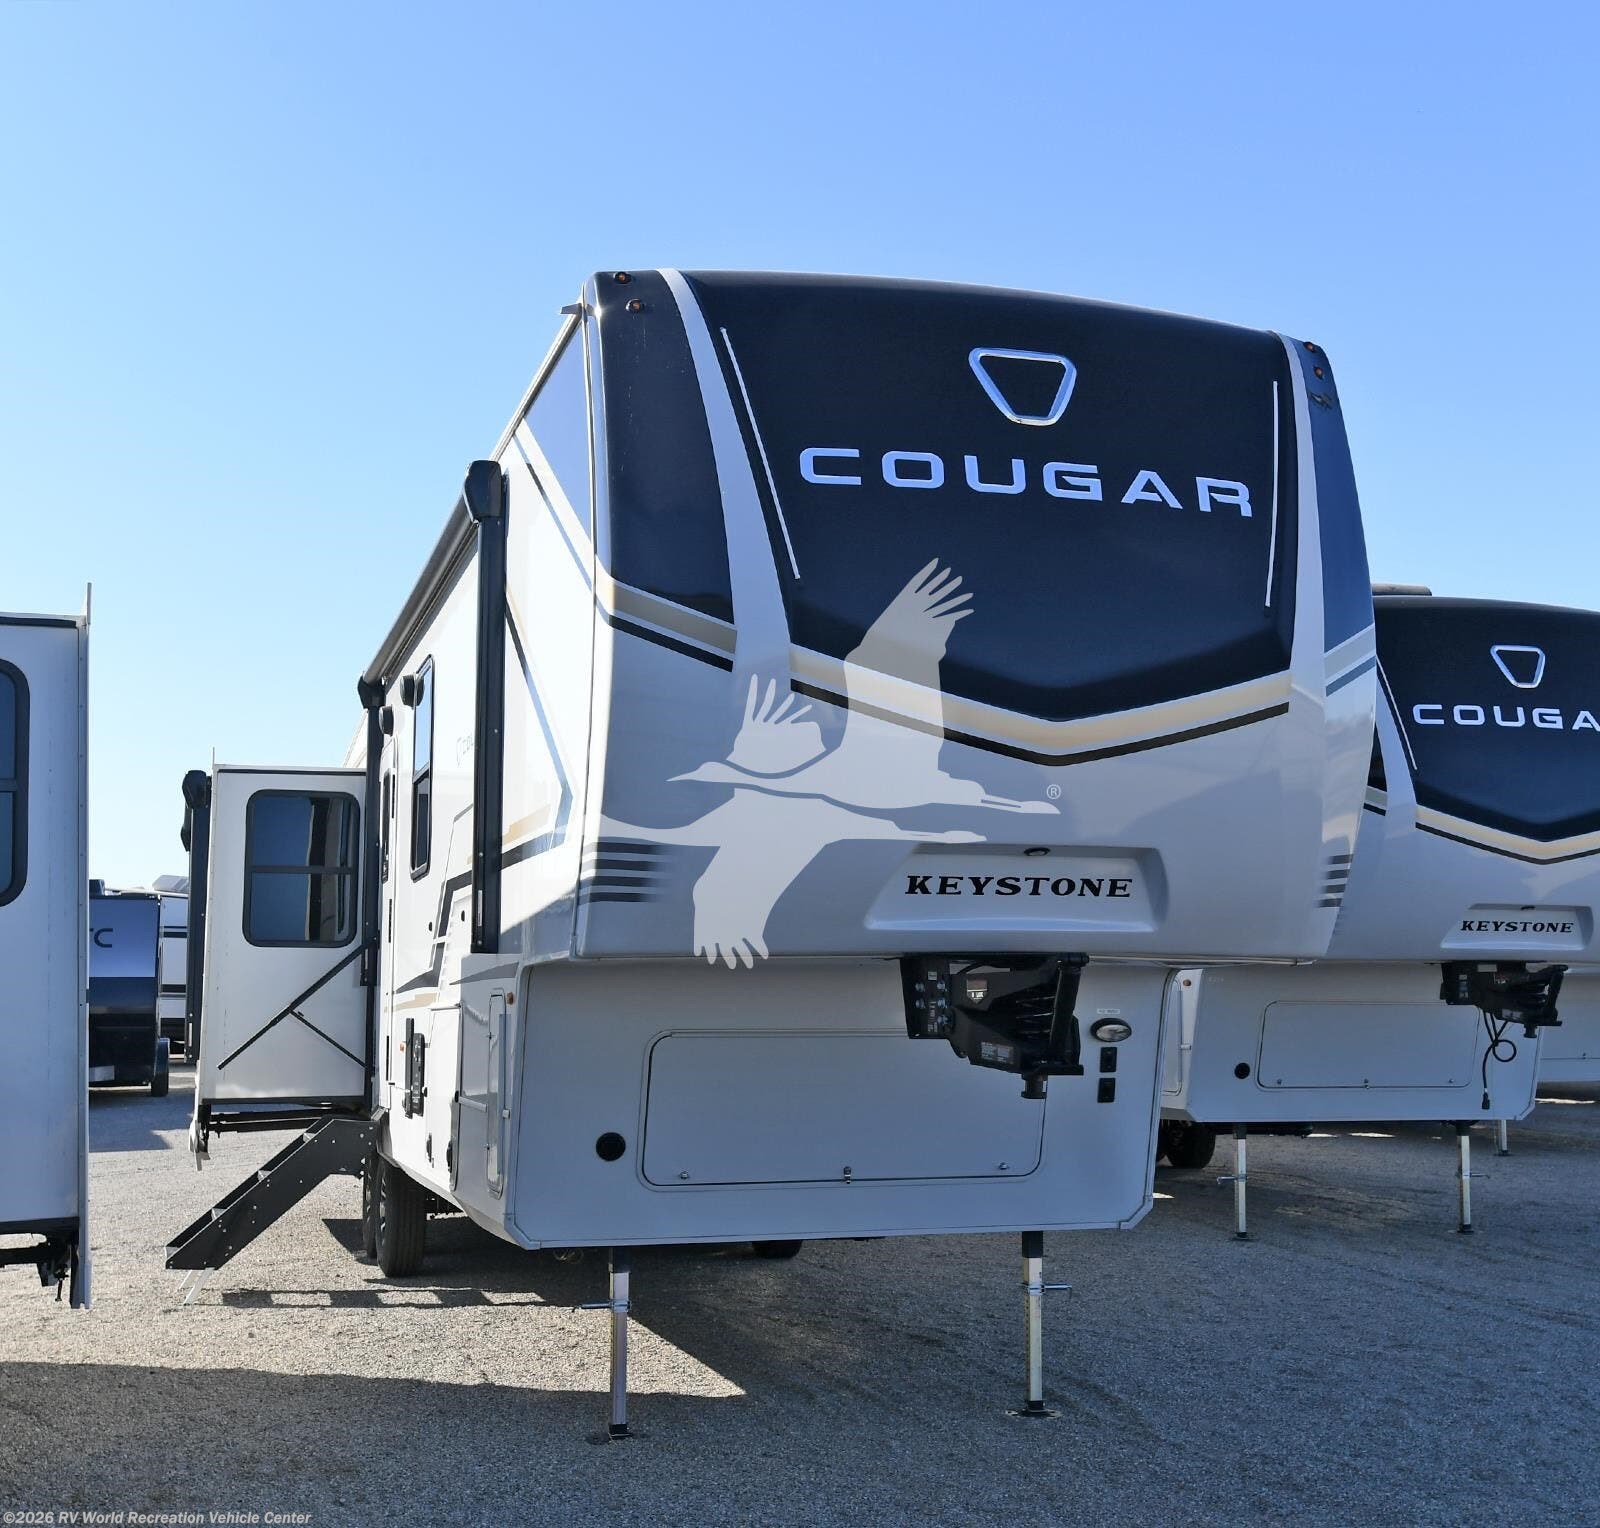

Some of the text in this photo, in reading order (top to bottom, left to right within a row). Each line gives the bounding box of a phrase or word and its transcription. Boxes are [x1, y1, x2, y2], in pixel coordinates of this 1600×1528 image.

[799, 446, 1253, 518] COUGAR
[1412, 703, 1600, 732] COUGA
[904, 874, 1133, 898] KEYSTONE
[1460, 920, 1575, 933] KEYSTONE
